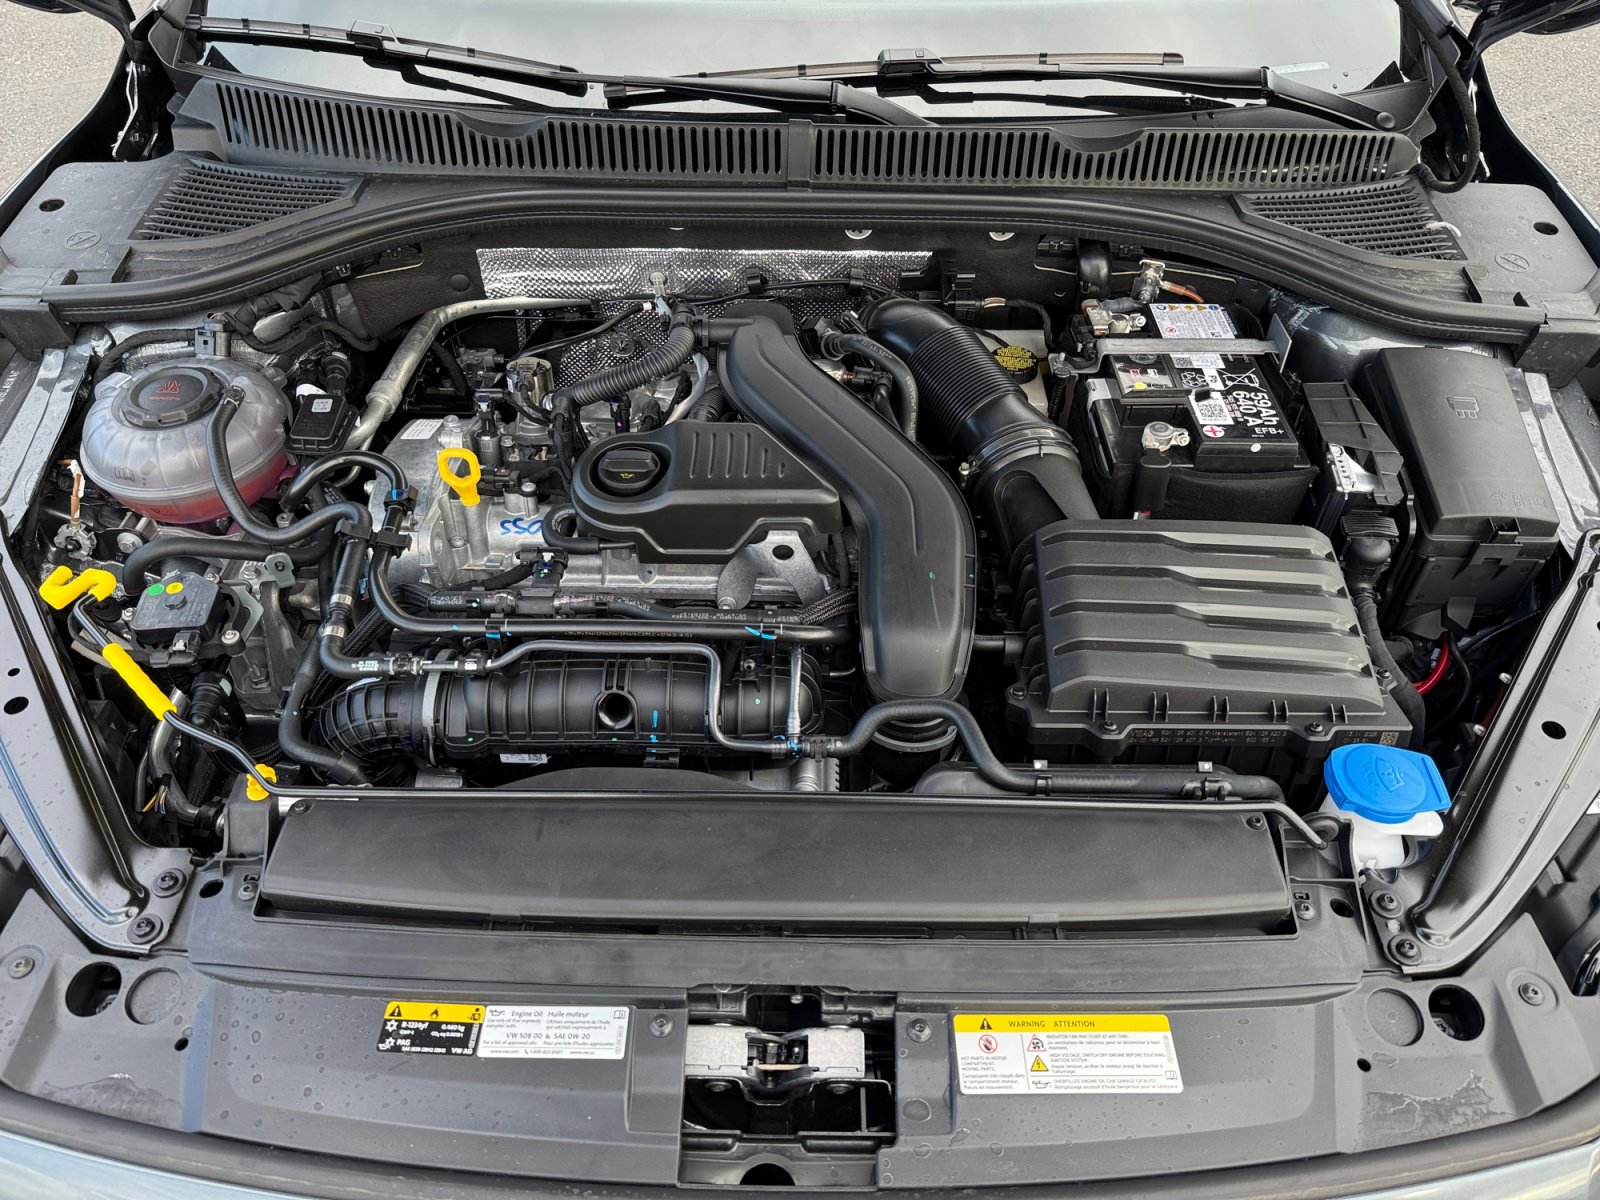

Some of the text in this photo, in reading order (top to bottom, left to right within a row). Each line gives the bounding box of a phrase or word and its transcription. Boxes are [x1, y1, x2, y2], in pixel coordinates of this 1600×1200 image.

[1208, 374, 1218, 384] Pb
[1232, 390, 1258, 414] 640
[1250, 392, 1280, 425] 59Ah
[1244, 416, 1264, 426] A
[1254, 427, 1284, 435] EFB+
[512, 1010, 544, 1018] Engine Oil
[401, 1021, 429, 1030] R-1234yf
[458, 1024, 465, 1032] kg
